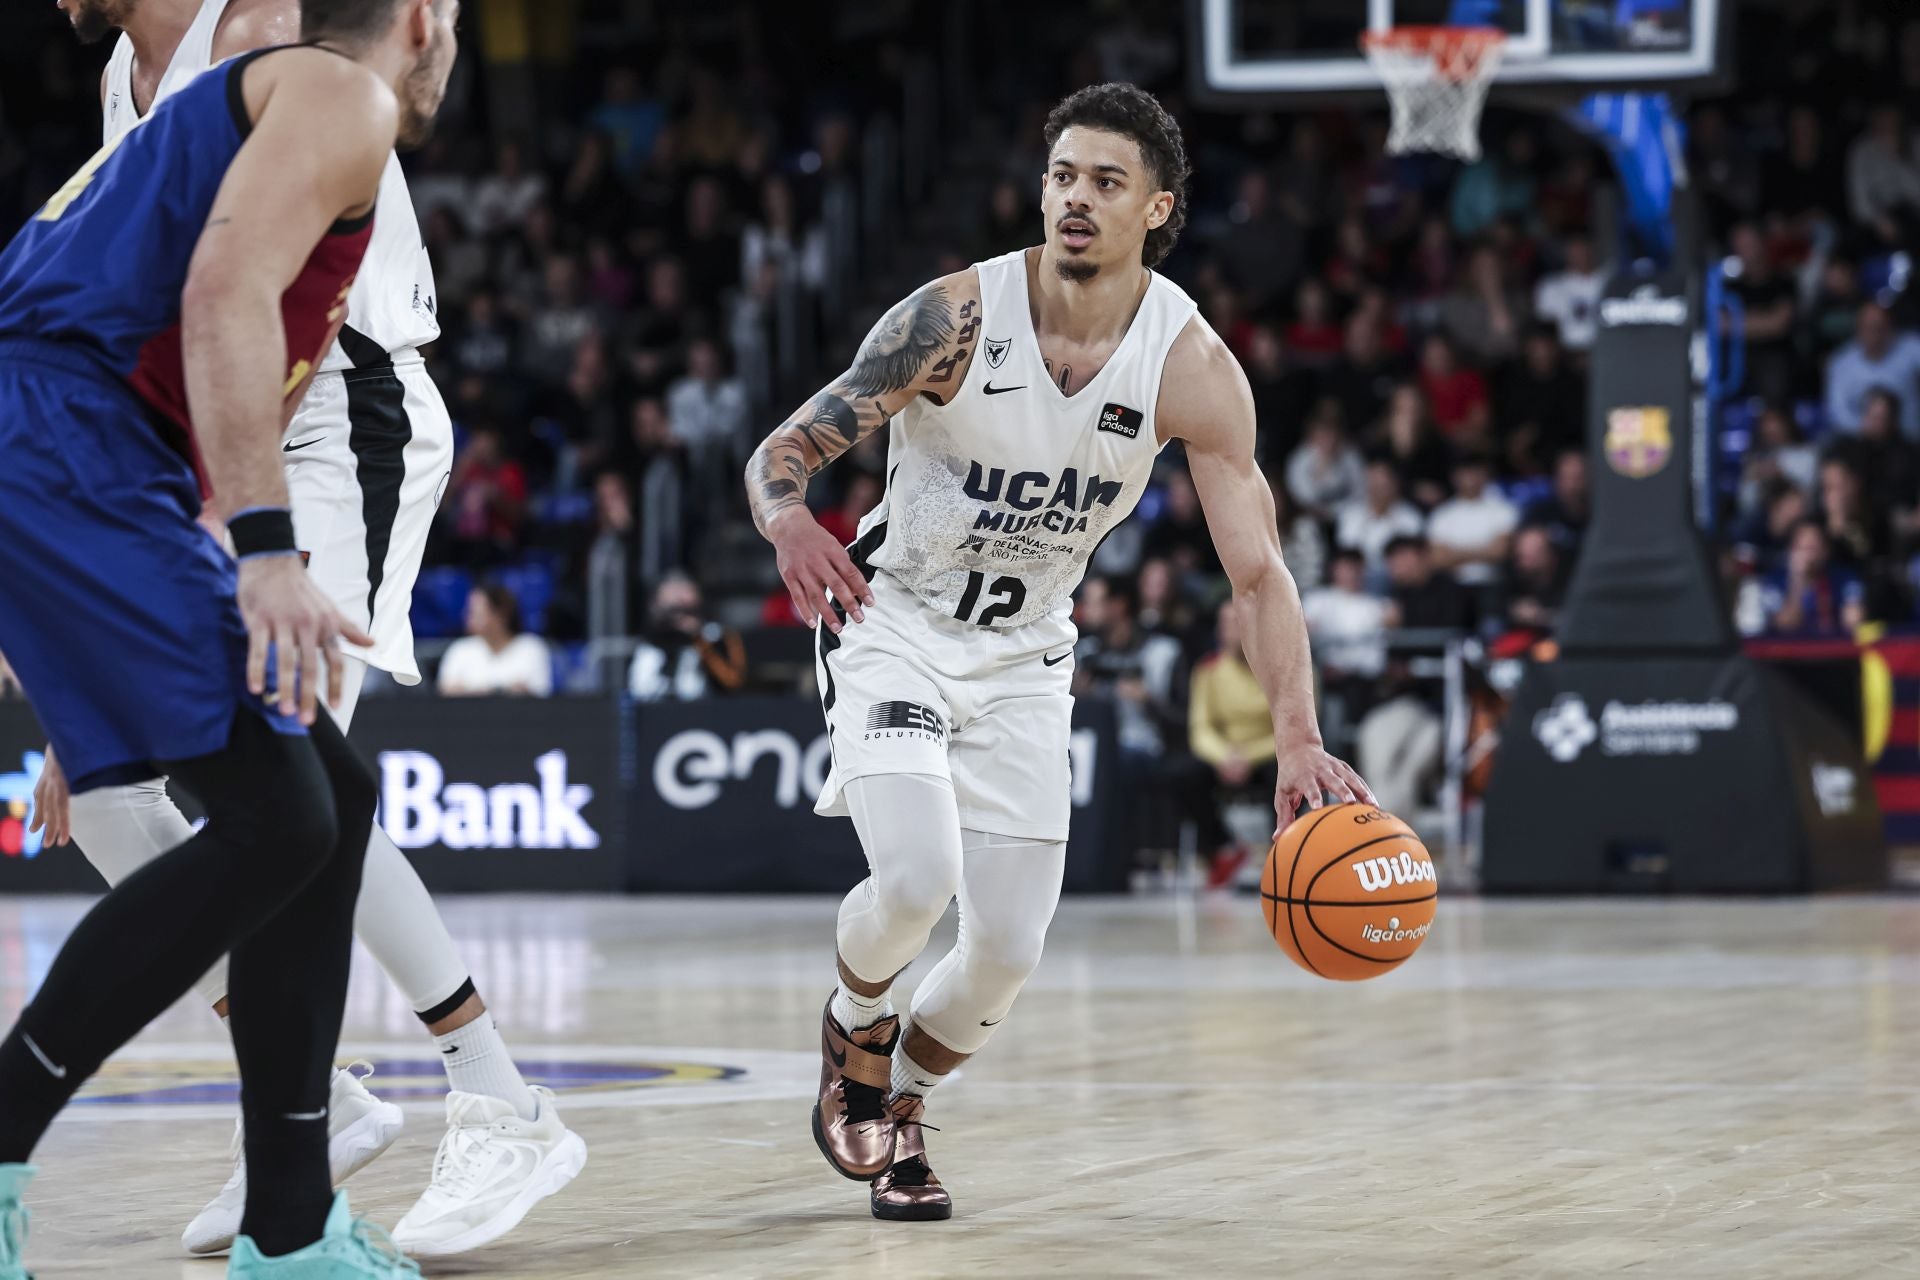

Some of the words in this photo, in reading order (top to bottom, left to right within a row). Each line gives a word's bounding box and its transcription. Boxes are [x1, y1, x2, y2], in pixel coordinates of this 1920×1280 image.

[1103, 411, 1118, 421] liga
[1101, 421, 1135, 435] endesa
[993, 540, 1007, 548] DE
[1007, 542, 1019, 552] LA
[953, 570, 1027, 626] 12
[1361, 924, 1394, 943] liga
